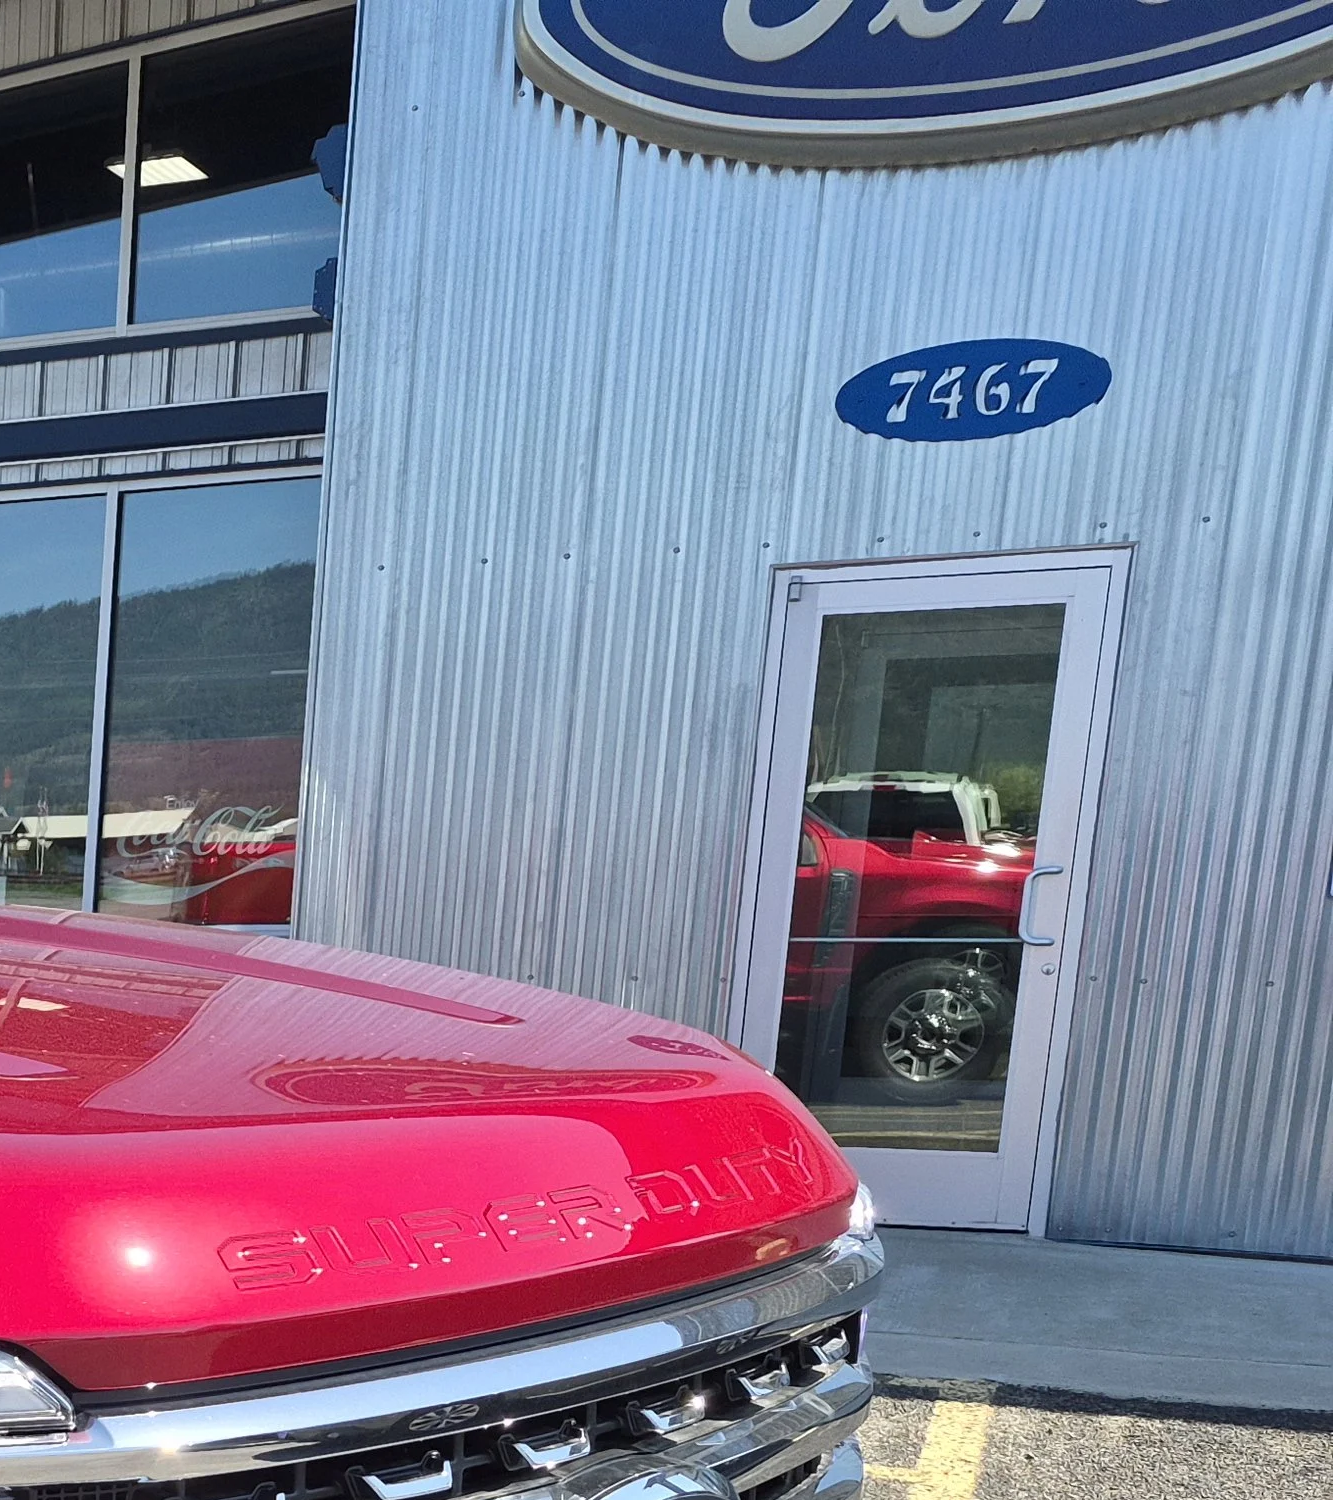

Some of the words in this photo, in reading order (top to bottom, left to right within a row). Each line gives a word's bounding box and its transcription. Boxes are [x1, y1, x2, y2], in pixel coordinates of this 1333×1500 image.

[886, 358, 1059, 423] 7467
[217, 1183, 633, 1292] SUPER
[625, 1137, 815, 1221] DUTY
